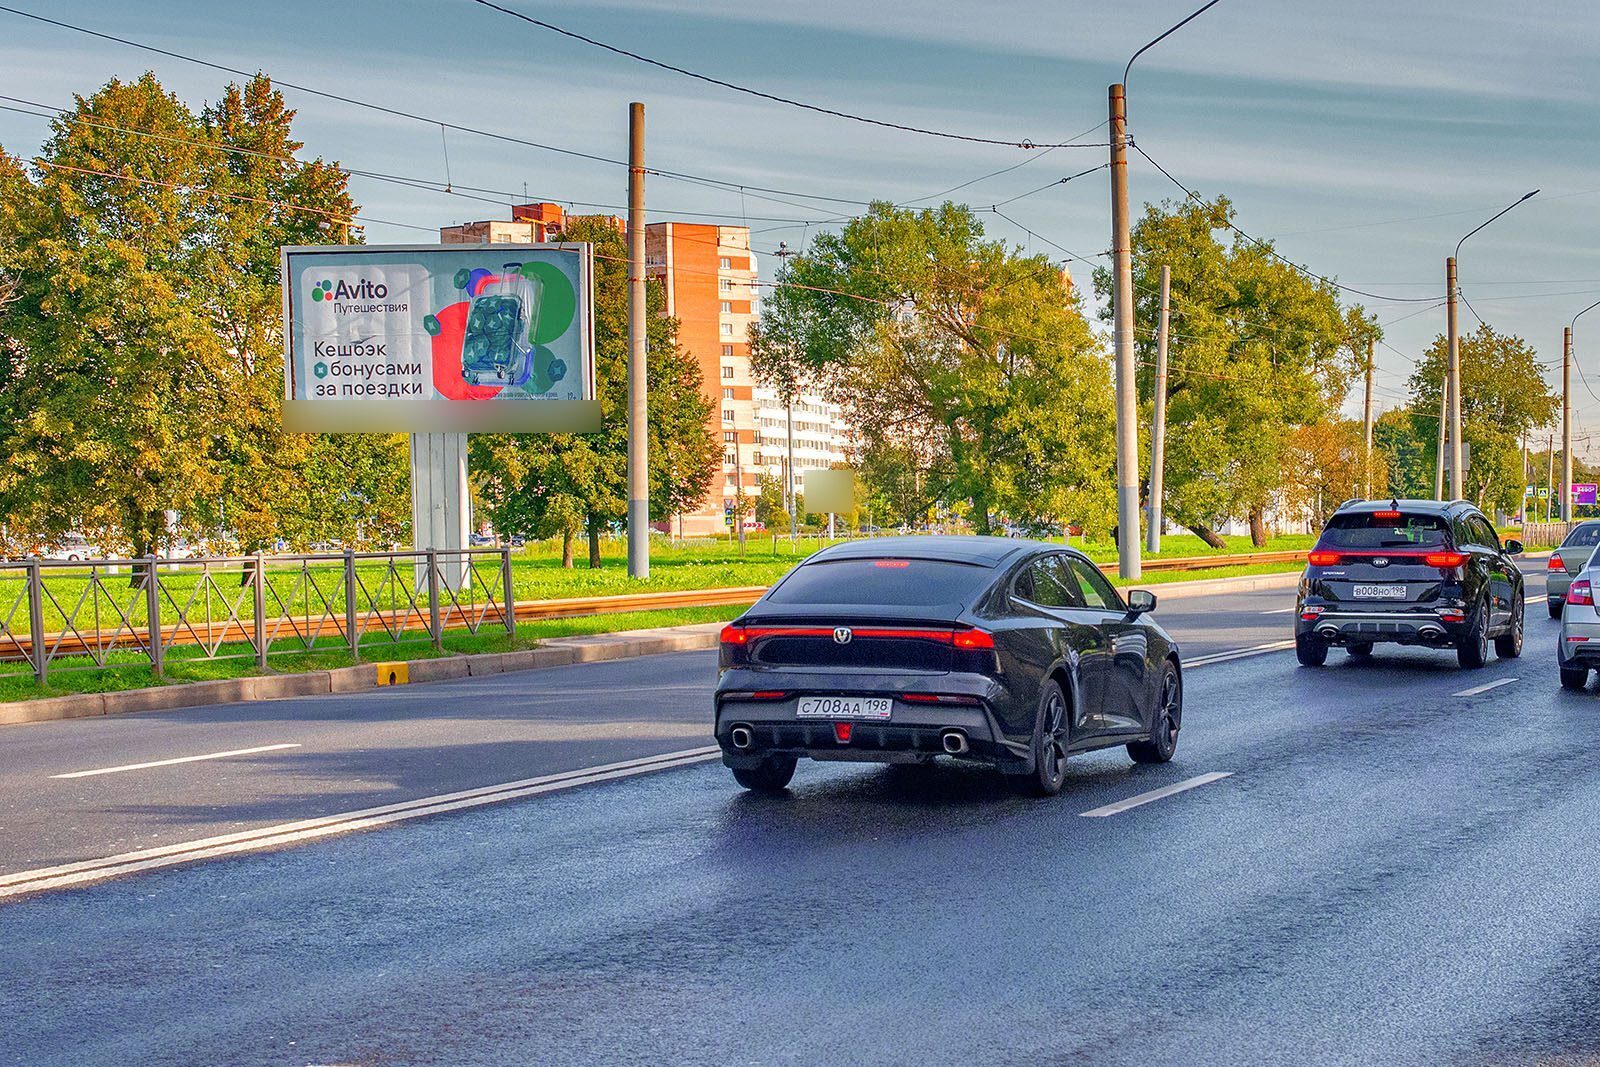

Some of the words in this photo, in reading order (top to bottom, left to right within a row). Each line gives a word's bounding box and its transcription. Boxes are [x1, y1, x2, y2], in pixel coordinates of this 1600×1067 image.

[334, 279, 388, 300] Avito
[334, 303, 408, 315] Путешествия
[314, 341, 387, 357] Кешбэк
[331, 361, 422, 380] бонусами
[316, 384, 337, 396] за
[342, 383, 423, 397] поездки
[865, 699, 888, 711] 198
